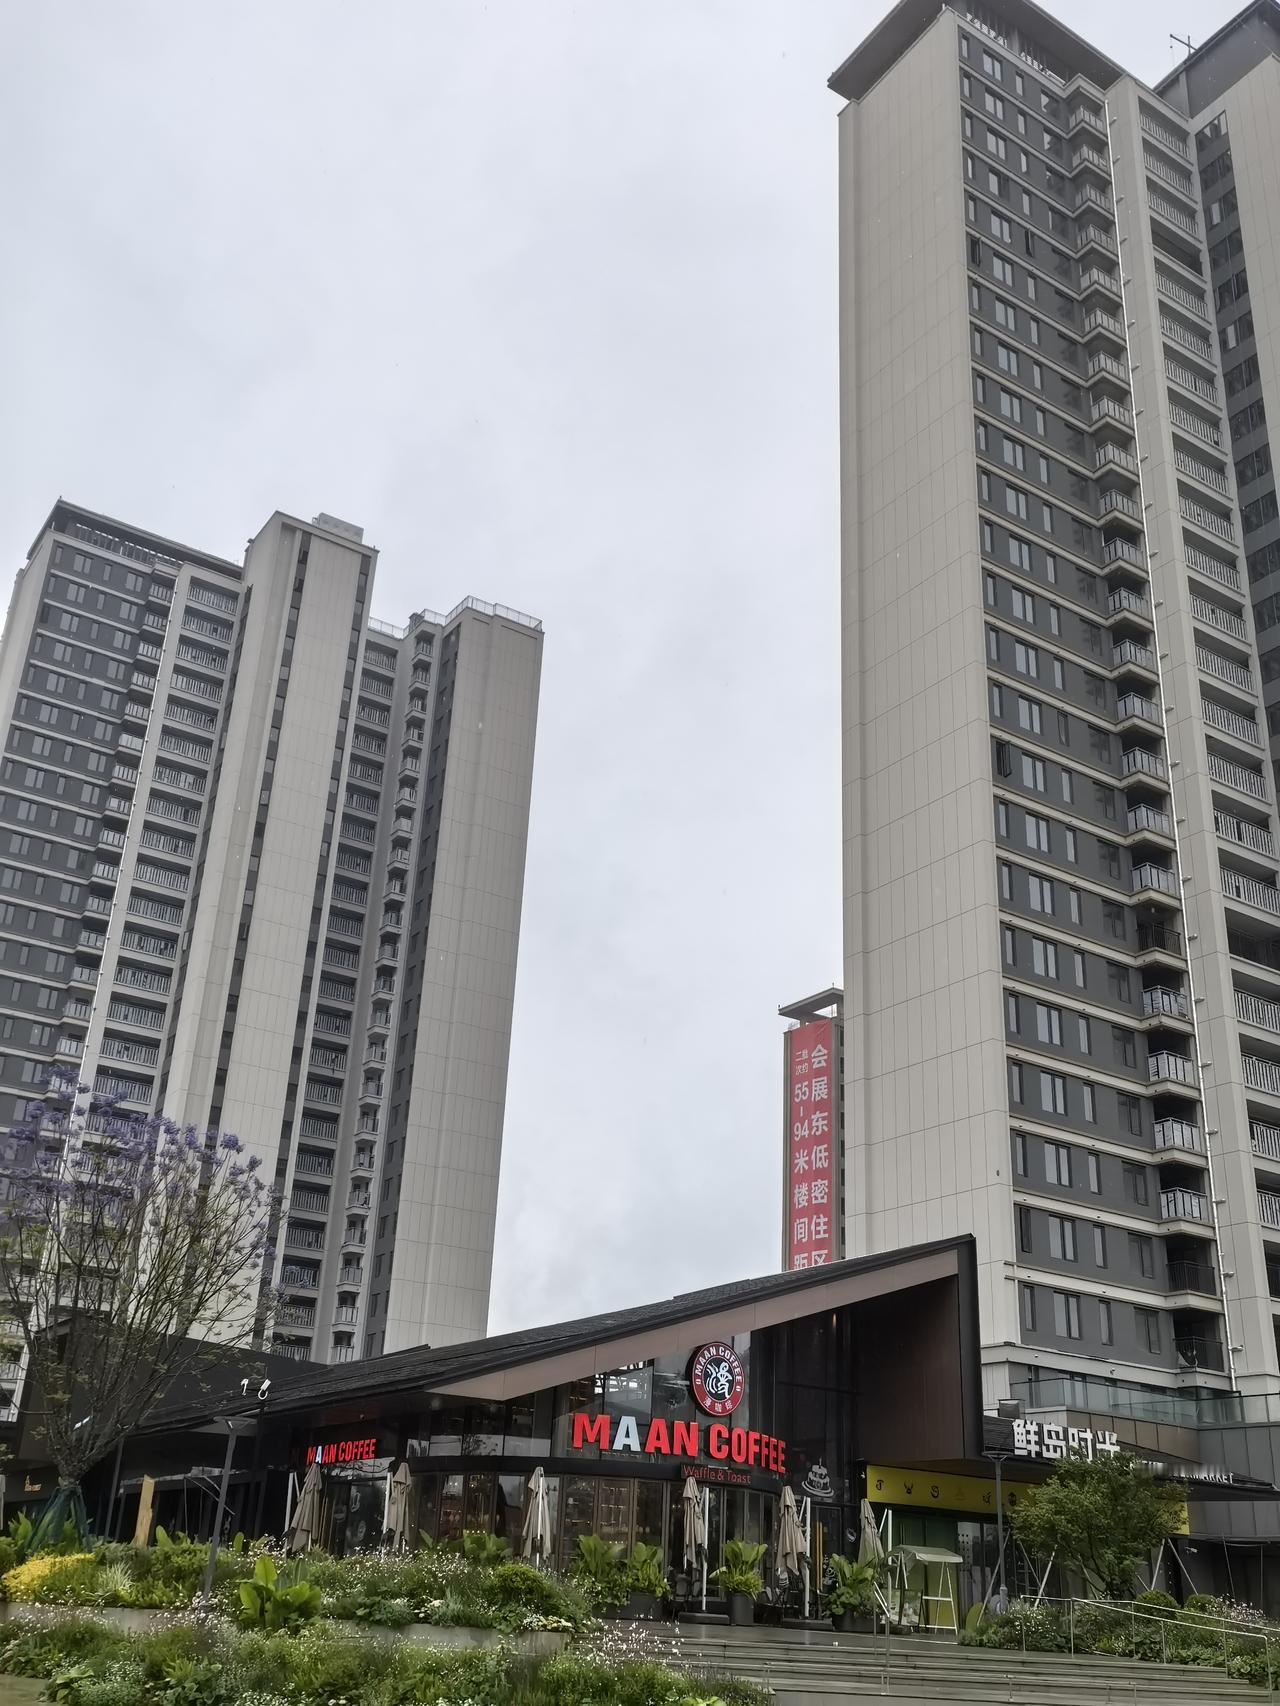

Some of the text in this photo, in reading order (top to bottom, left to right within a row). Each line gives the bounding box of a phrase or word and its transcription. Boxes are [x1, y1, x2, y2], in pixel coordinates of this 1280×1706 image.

[695, 1346, 742, 1382] MAAN COFFEE
[307, 1439, 376, 1465] MAAN COFFEE
[573, 1413, 786, 1474] MAAN COFFEE
[683, 1465, 752, 1483] Waffle & Toast
